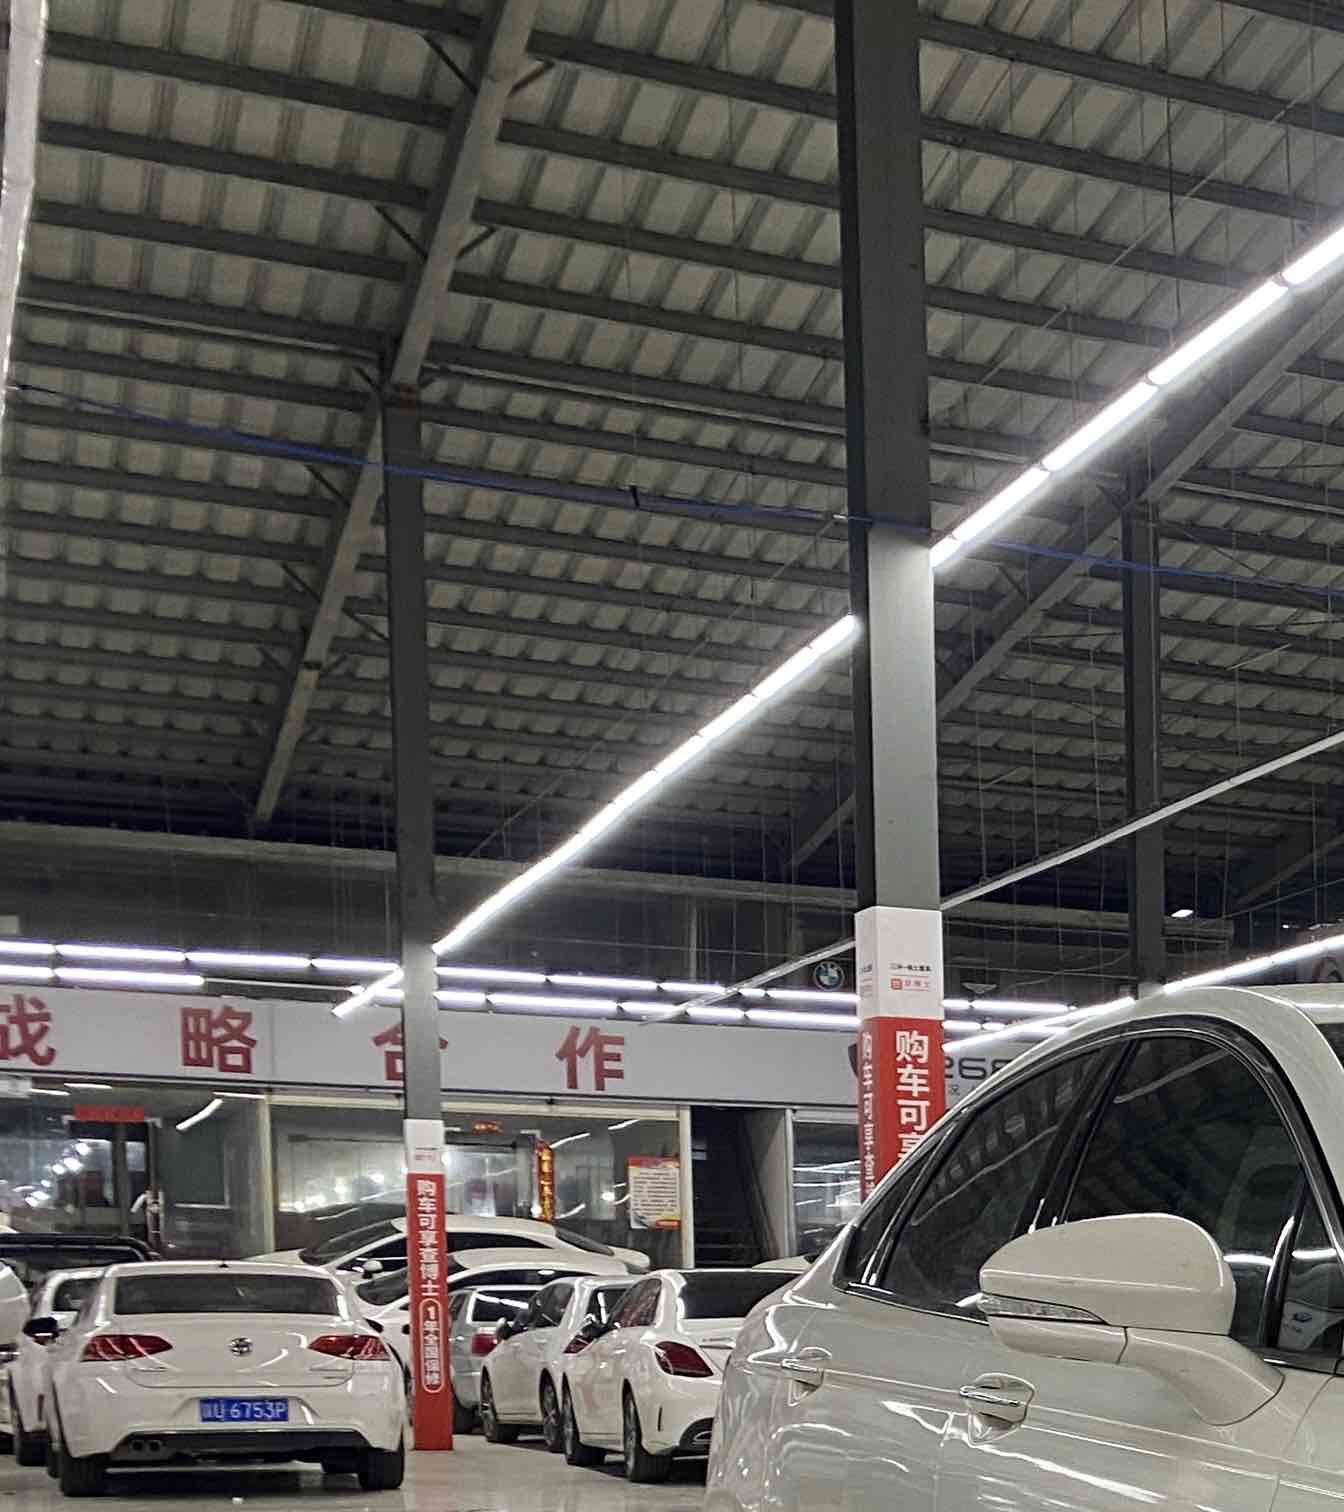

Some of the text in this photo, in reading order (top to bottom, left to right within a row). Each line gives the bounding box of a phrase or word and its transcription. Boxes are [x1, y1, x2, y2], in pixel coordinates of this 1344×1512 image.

[416, 1179, 441, 1297] 购车可享查博士
